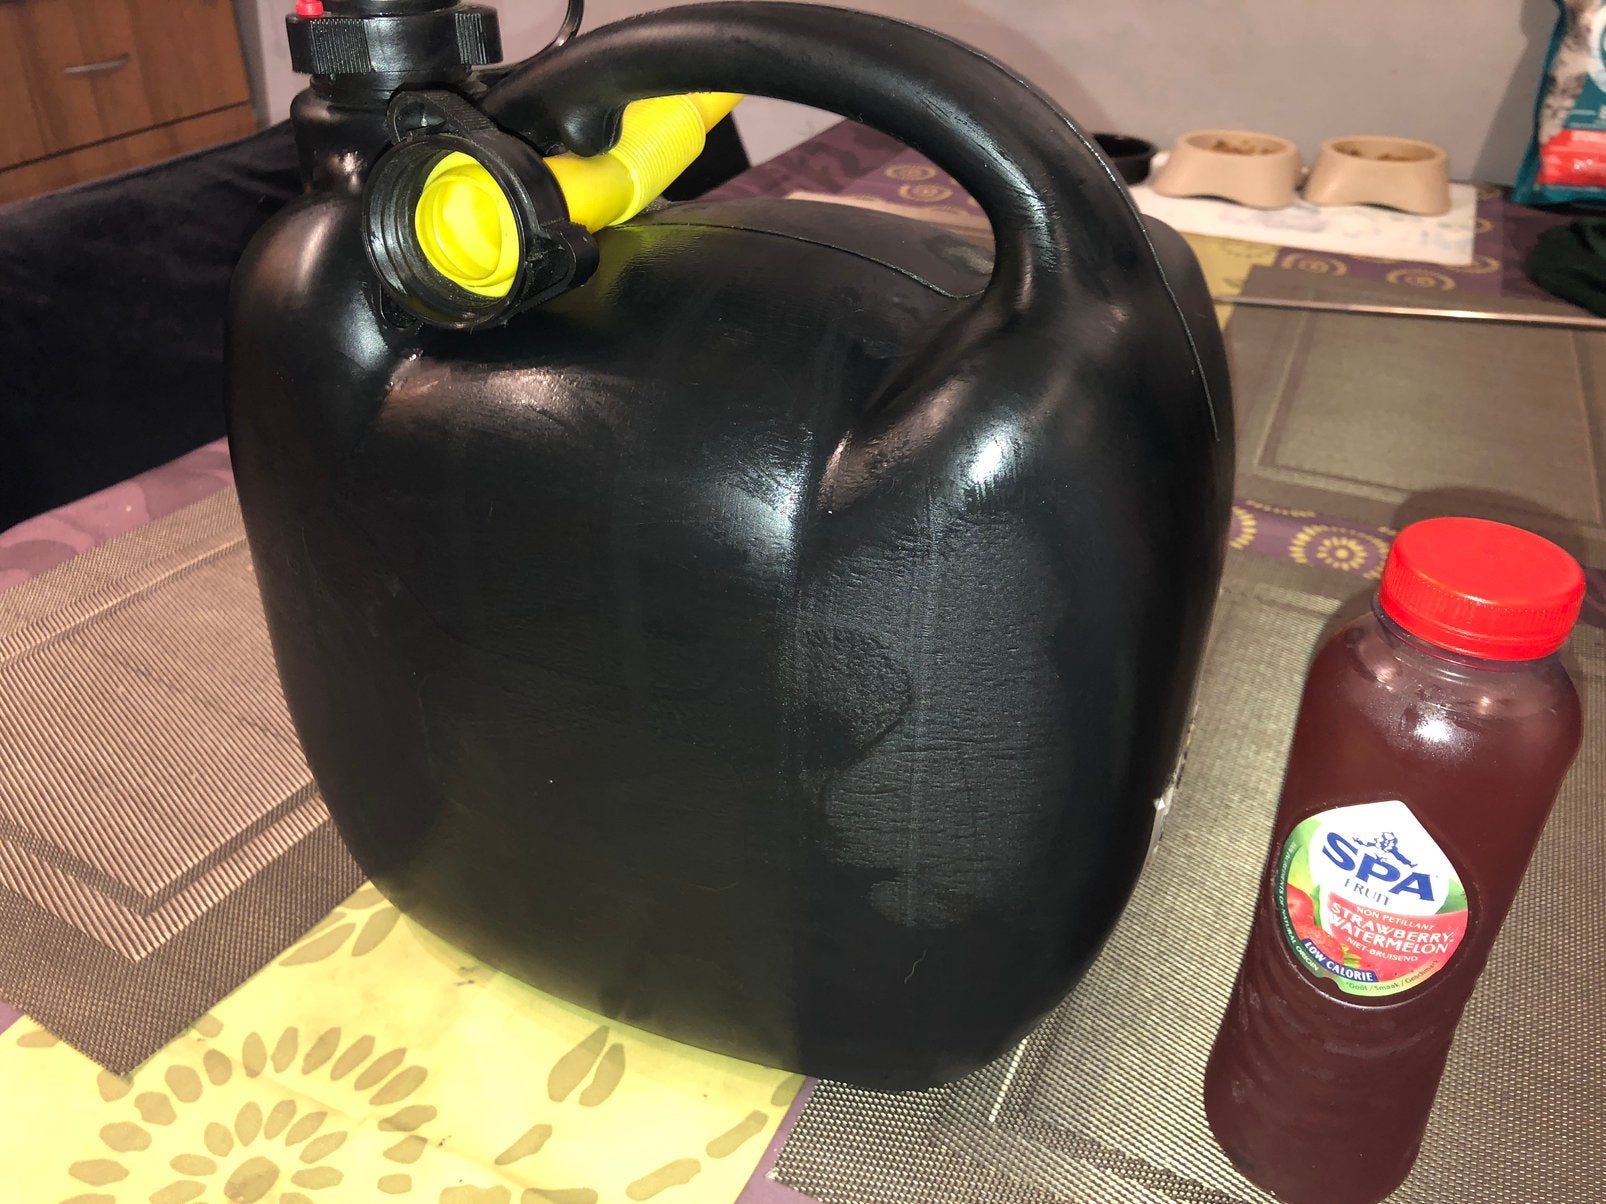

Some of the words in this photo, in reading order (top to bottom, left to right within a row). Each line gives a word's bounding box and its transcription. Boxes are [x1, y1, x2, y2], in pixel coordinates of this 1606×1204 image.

[1322, 832, 1435, 902] SPA
[1344, 878, 1390, 906] FRUIT
[1356, 906, 1380, 919] NON
[1280, 908, 1297, 944] NATURAL
[1295, 945, 1319, 971] ORIGIN
[1329, 913, 1449, 954] WATERMELON
[1304, 941, 1327, 962] LOW
[1326, 960, 1374, 982] CALORIE
